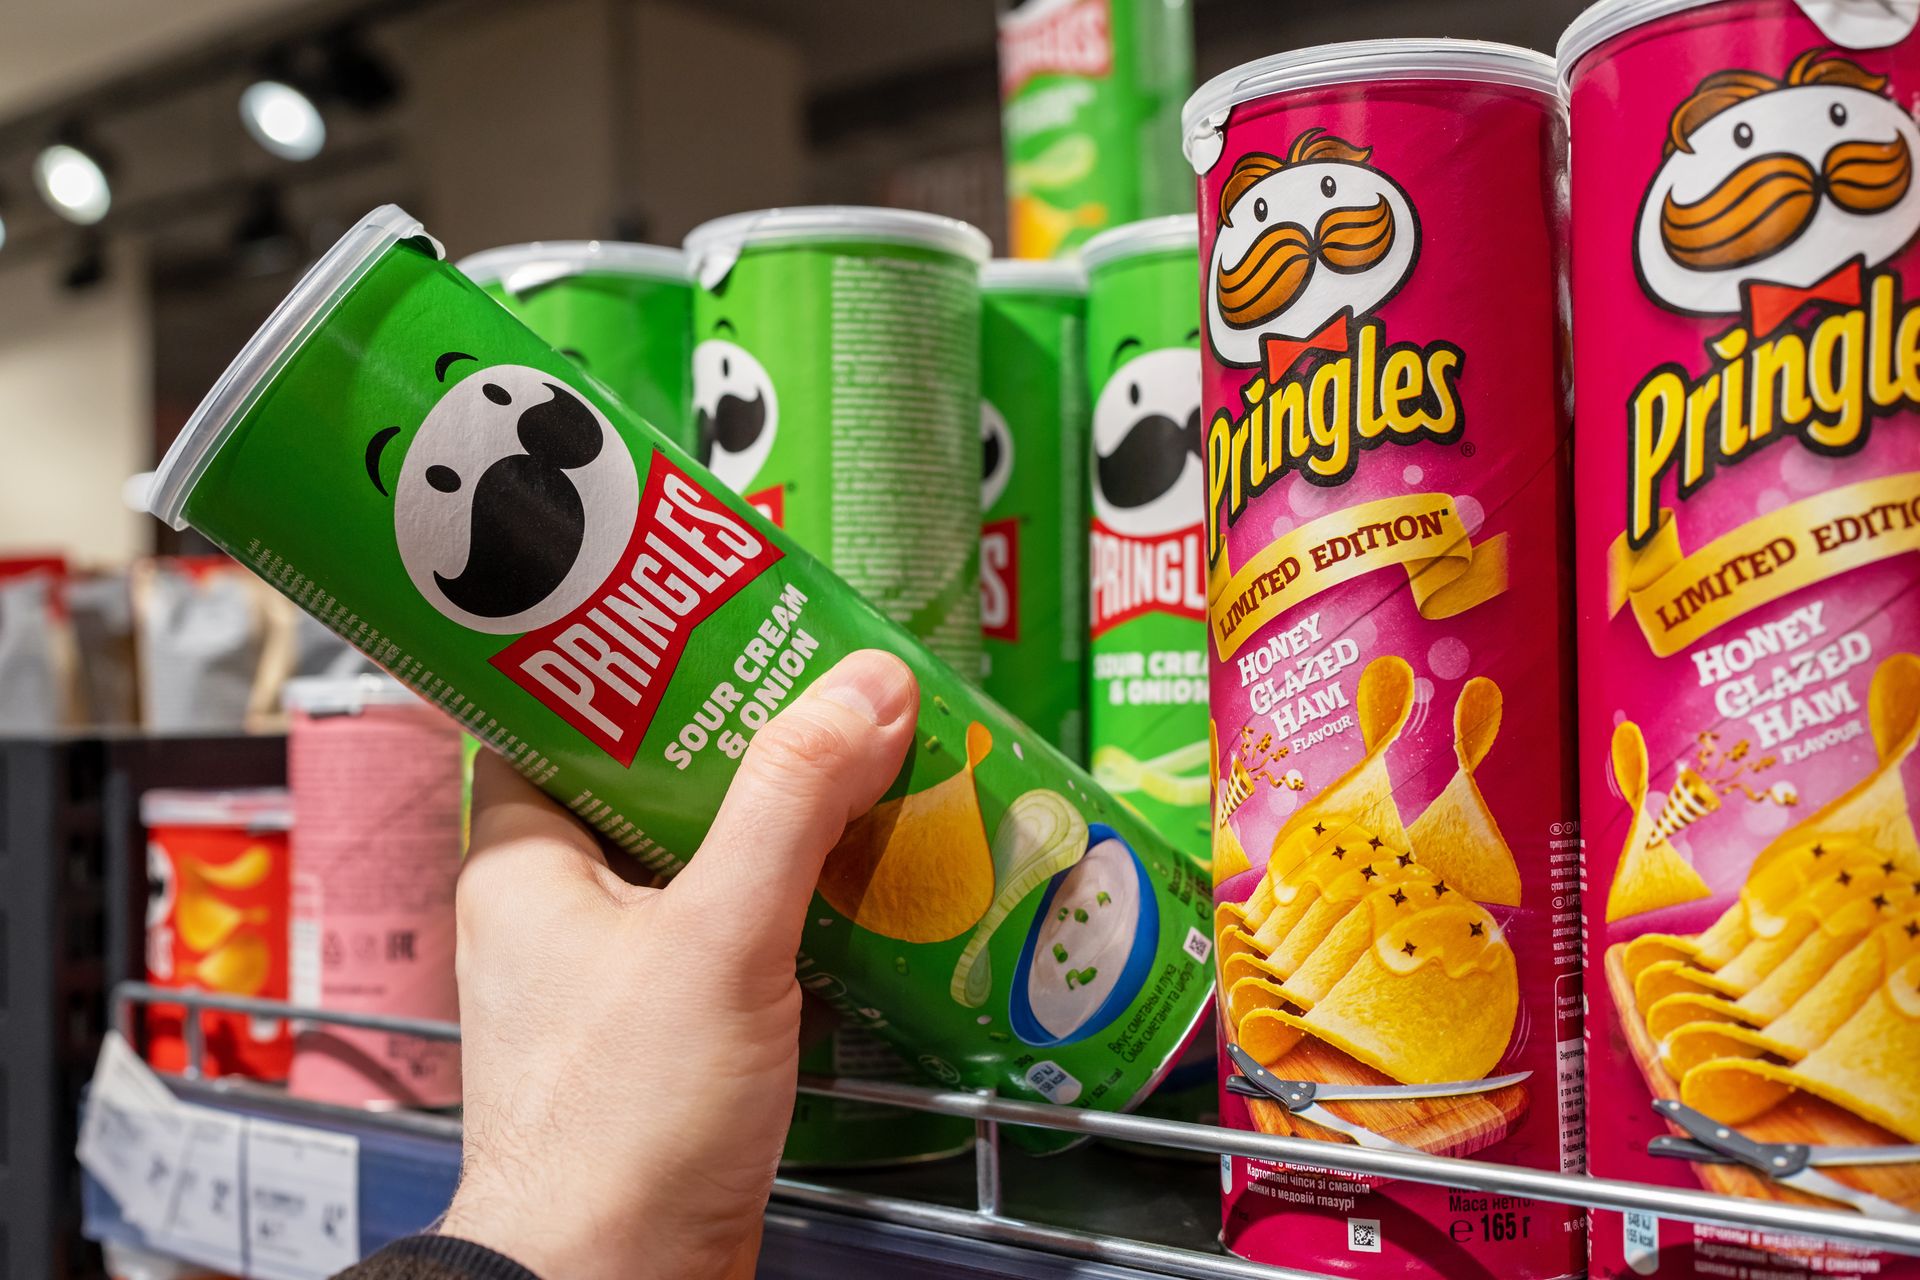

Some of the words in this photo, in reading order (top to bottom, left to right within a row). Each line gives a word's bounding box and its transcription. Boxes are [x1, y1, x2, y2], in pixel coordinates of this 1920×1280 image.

[1205, 320, 1464, 568] Pringles
[519, 473, 763, 743] PRINGLES
[1218, 556, 1301, 642] LIMITED
[1309, 510, 1444, 572] EDITION
[1656, 537, 1796, 632] LIMITED
[663, 681, 743, 771] SOUR
[734, 583, 810, 682] CREAM
[731, 628, 820, 732] ONION
[1237, 612, 1323, 688] HONEY
[1249, 638, 1360, 716] GLAZED
[1691, 601, 1828, 686] HONEY
[1714, 631, 1872, 719] GLAZED
[716, 730, 750, 760] &
[1270, 681, 1349, 742] HAM
[1291, 715, 1355, 754] FLAVOUR
[1748, 681, 1861, 750] HAM
[1781, 719, 1863, 766] FLAVOUR
[1247, 1163, 1288, 1184] Картопляні
[1290, 1173, 1315, 1190] чіпси
[1318, 1178, 1326, 1190] зі
[1329, 1181, 1371, 1194] смаком
[1247, 1181, 1270, 1197] шинки
[1271, 1190, 1276, 1198] в
[1278, 1189, 1315, 1206] медовій
[1317, 1195, 1355, 1211] глазурі
[1449, 1195, 1488, 1213] Маса
[1481, 1212, 1517, 1242] 165
